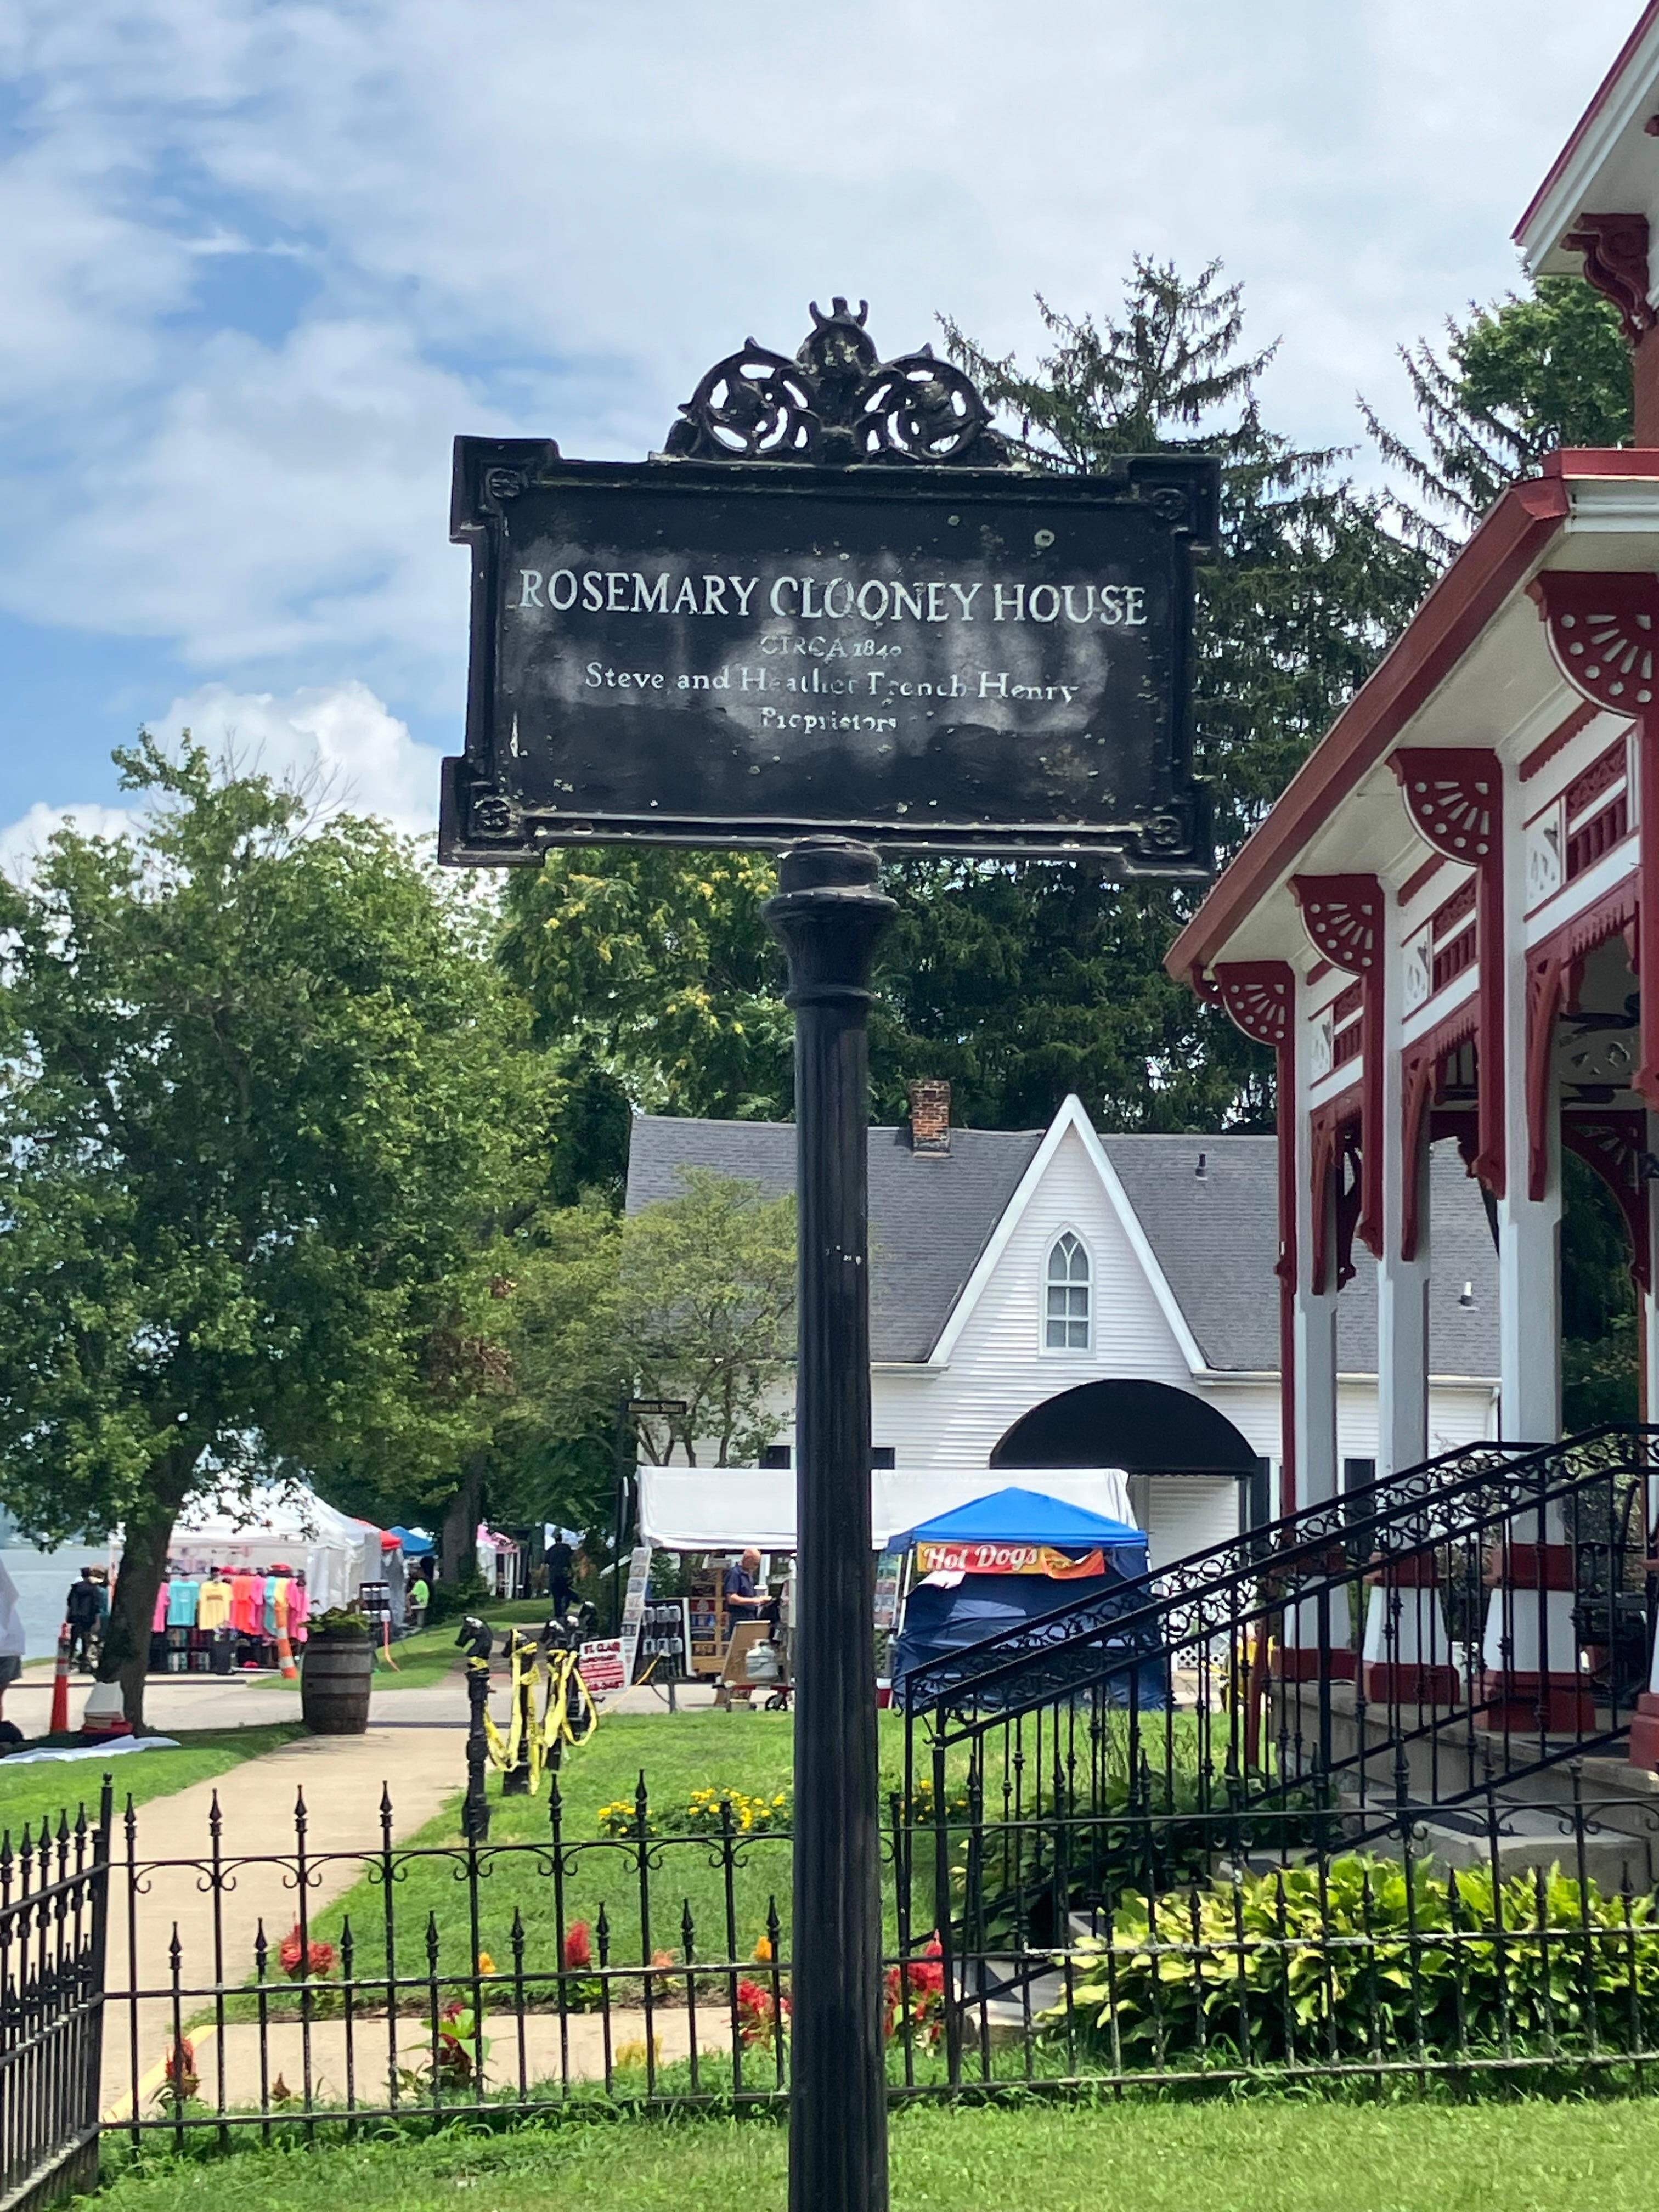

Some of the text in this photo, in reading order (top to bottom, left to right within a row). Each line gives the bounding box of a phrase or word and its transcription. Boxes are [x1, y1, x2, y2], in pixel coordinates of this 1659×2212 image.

[518, 569, 1148, 625] ROSEMARY CLOONEY HOUSE
[760, 636, 902, 660] CIRCA 1840
[585, 662, 664, 688] Steve
[677, 664, 731, 690] and
[923, 1544, 1037, 1572] Hot Dogs
